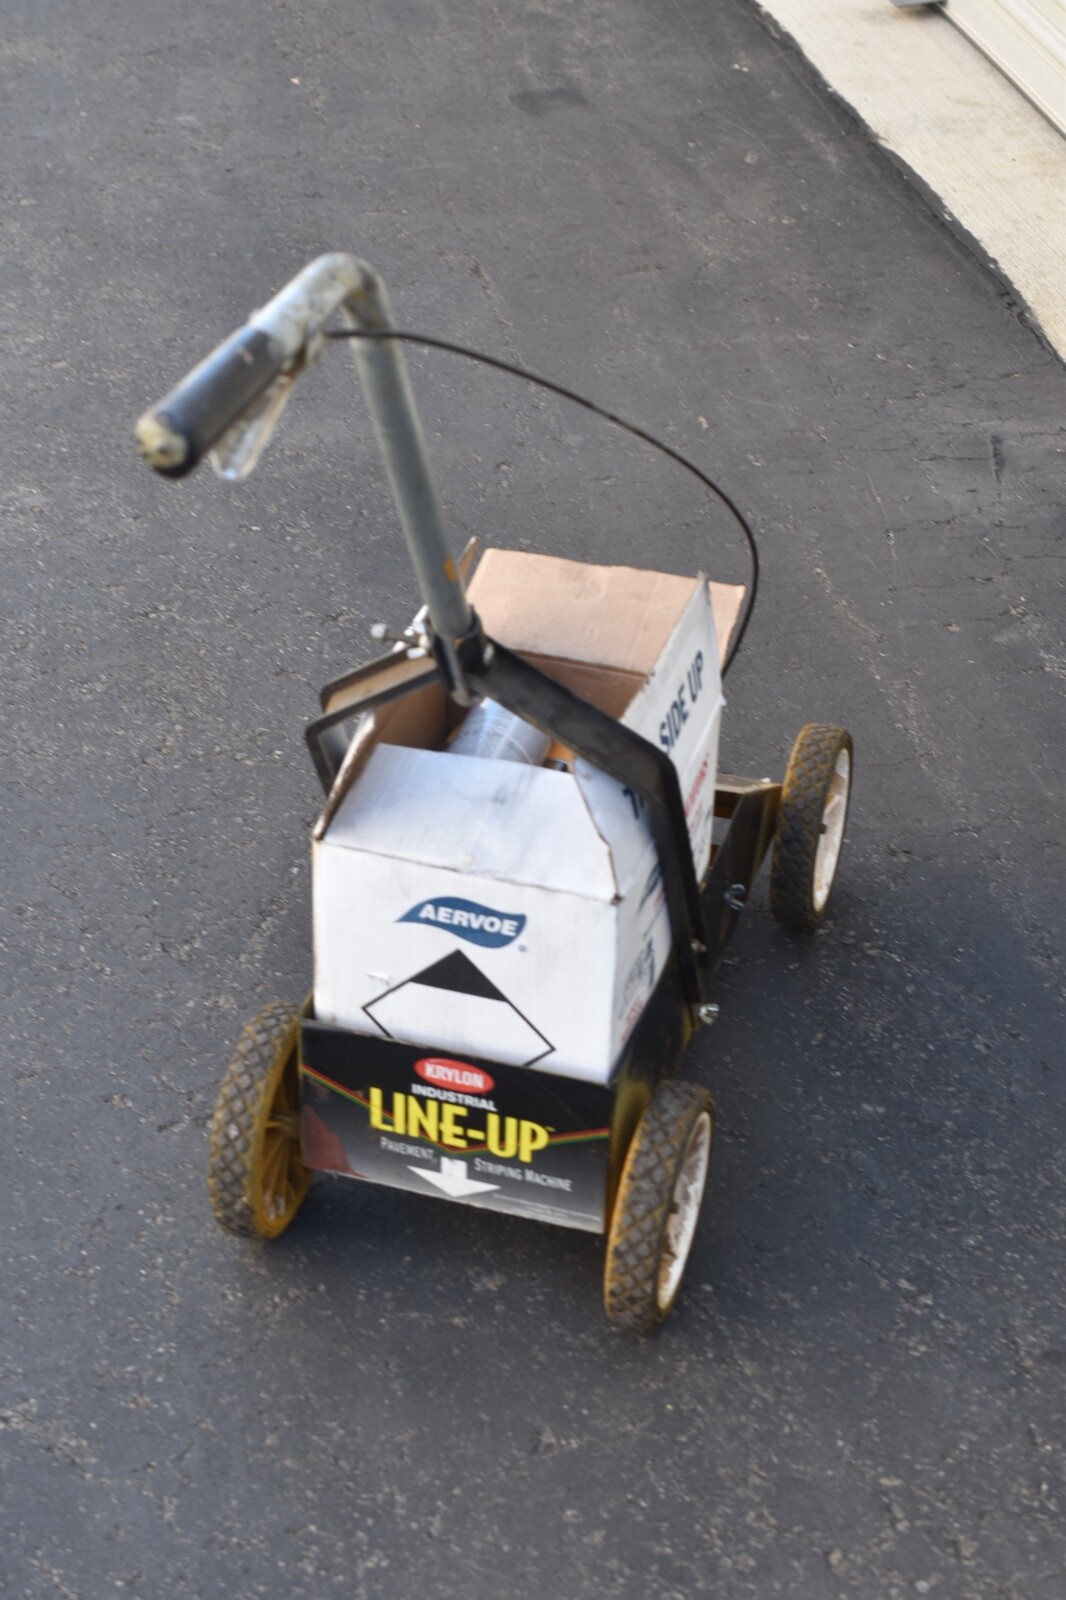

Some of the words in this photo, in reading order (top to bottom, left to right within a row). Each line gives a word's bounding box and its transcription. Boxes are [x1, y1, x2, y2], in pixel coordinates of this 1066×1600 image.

[660, 683, 689, 757] SIDE
[687, 649, 703, 703] UP
[418, 903, 518, 937] AERVOE
[424, 1063, 484, 1089] KRYLON
[411, 1083, 498, 1112] INDUSTRIAL
[369, 1086, 549, 1163] LINE-UP
[380, 1136, 435, 1161] PAVEMENT
[474, 1157, 523, 1181] STRIPING
[525, 1168, 573, 1192] MACHINE
